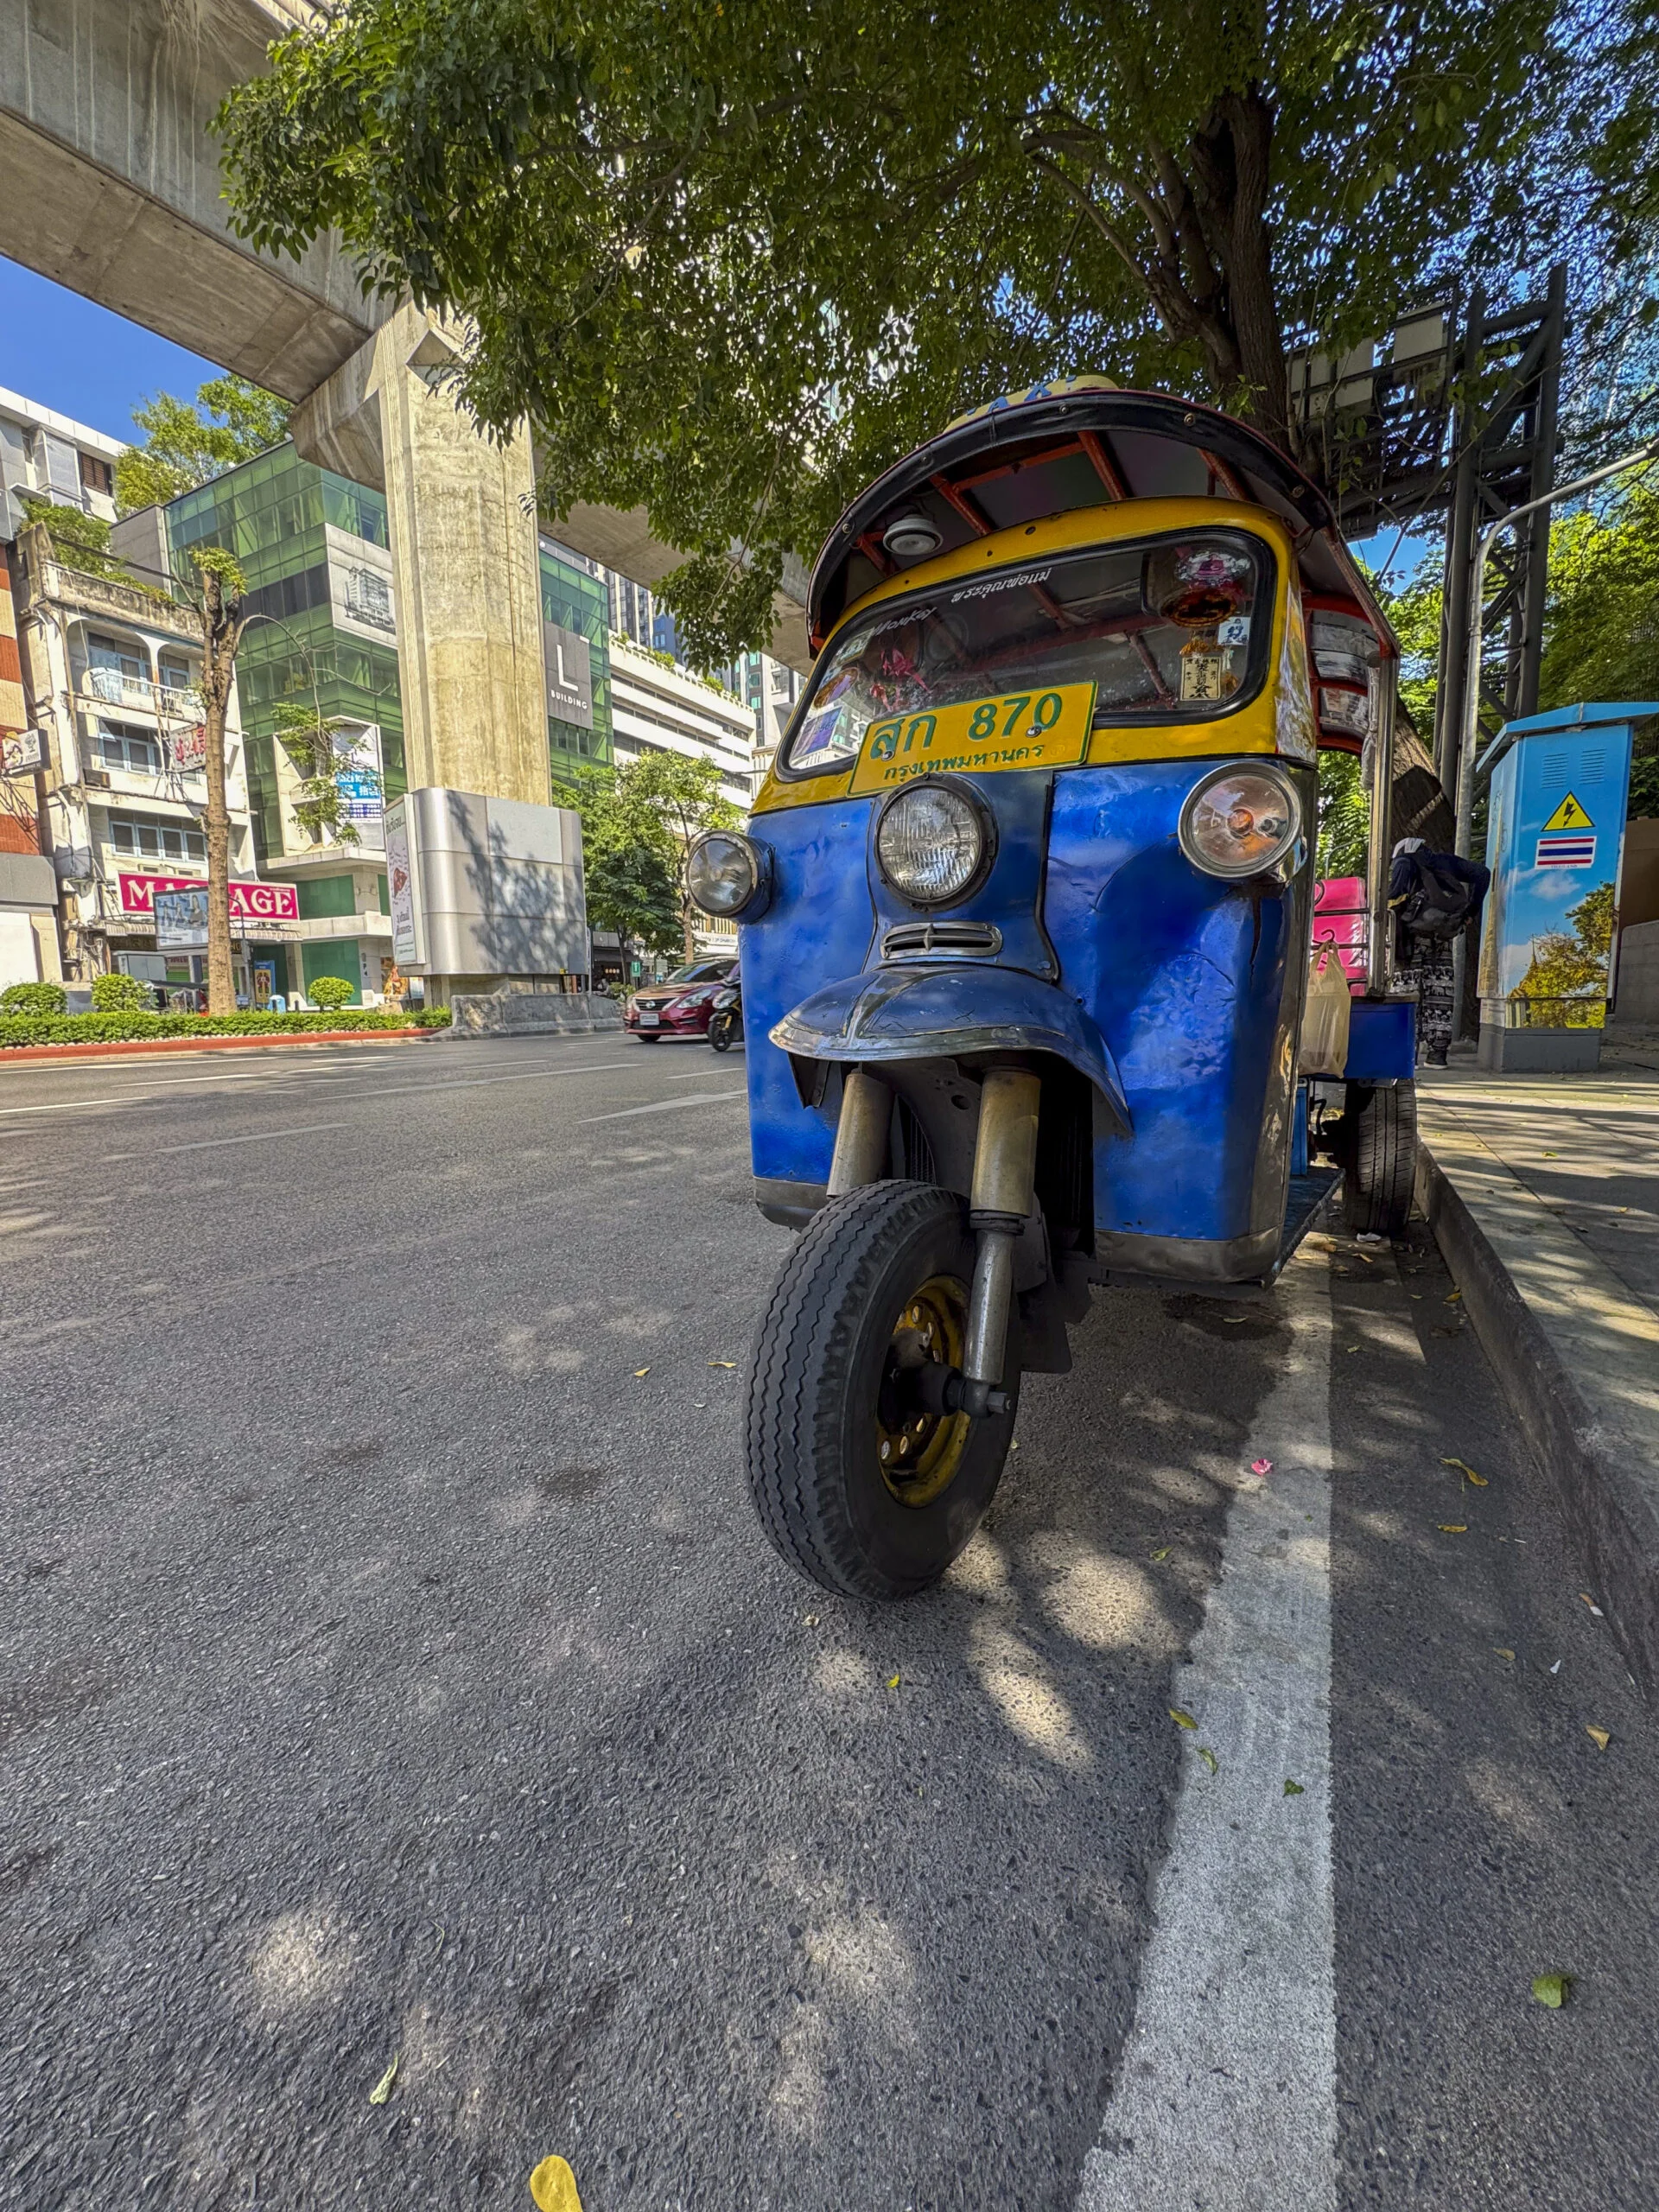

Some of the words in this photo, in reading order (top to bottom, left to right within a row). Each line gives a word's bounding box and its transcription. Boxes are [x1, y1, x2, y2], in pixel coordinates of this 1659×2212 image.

[951, 567, 1052, 603] พระคุณพ่อแม่
[556, 644, 579, 691] L
[551, 690, 588, 709] BUILDING
[869, 712, 938, 761] สก
[967, 692, 1063, 744] 870
[883, 744, 1046, 784] กรุงเทพมหานคร
